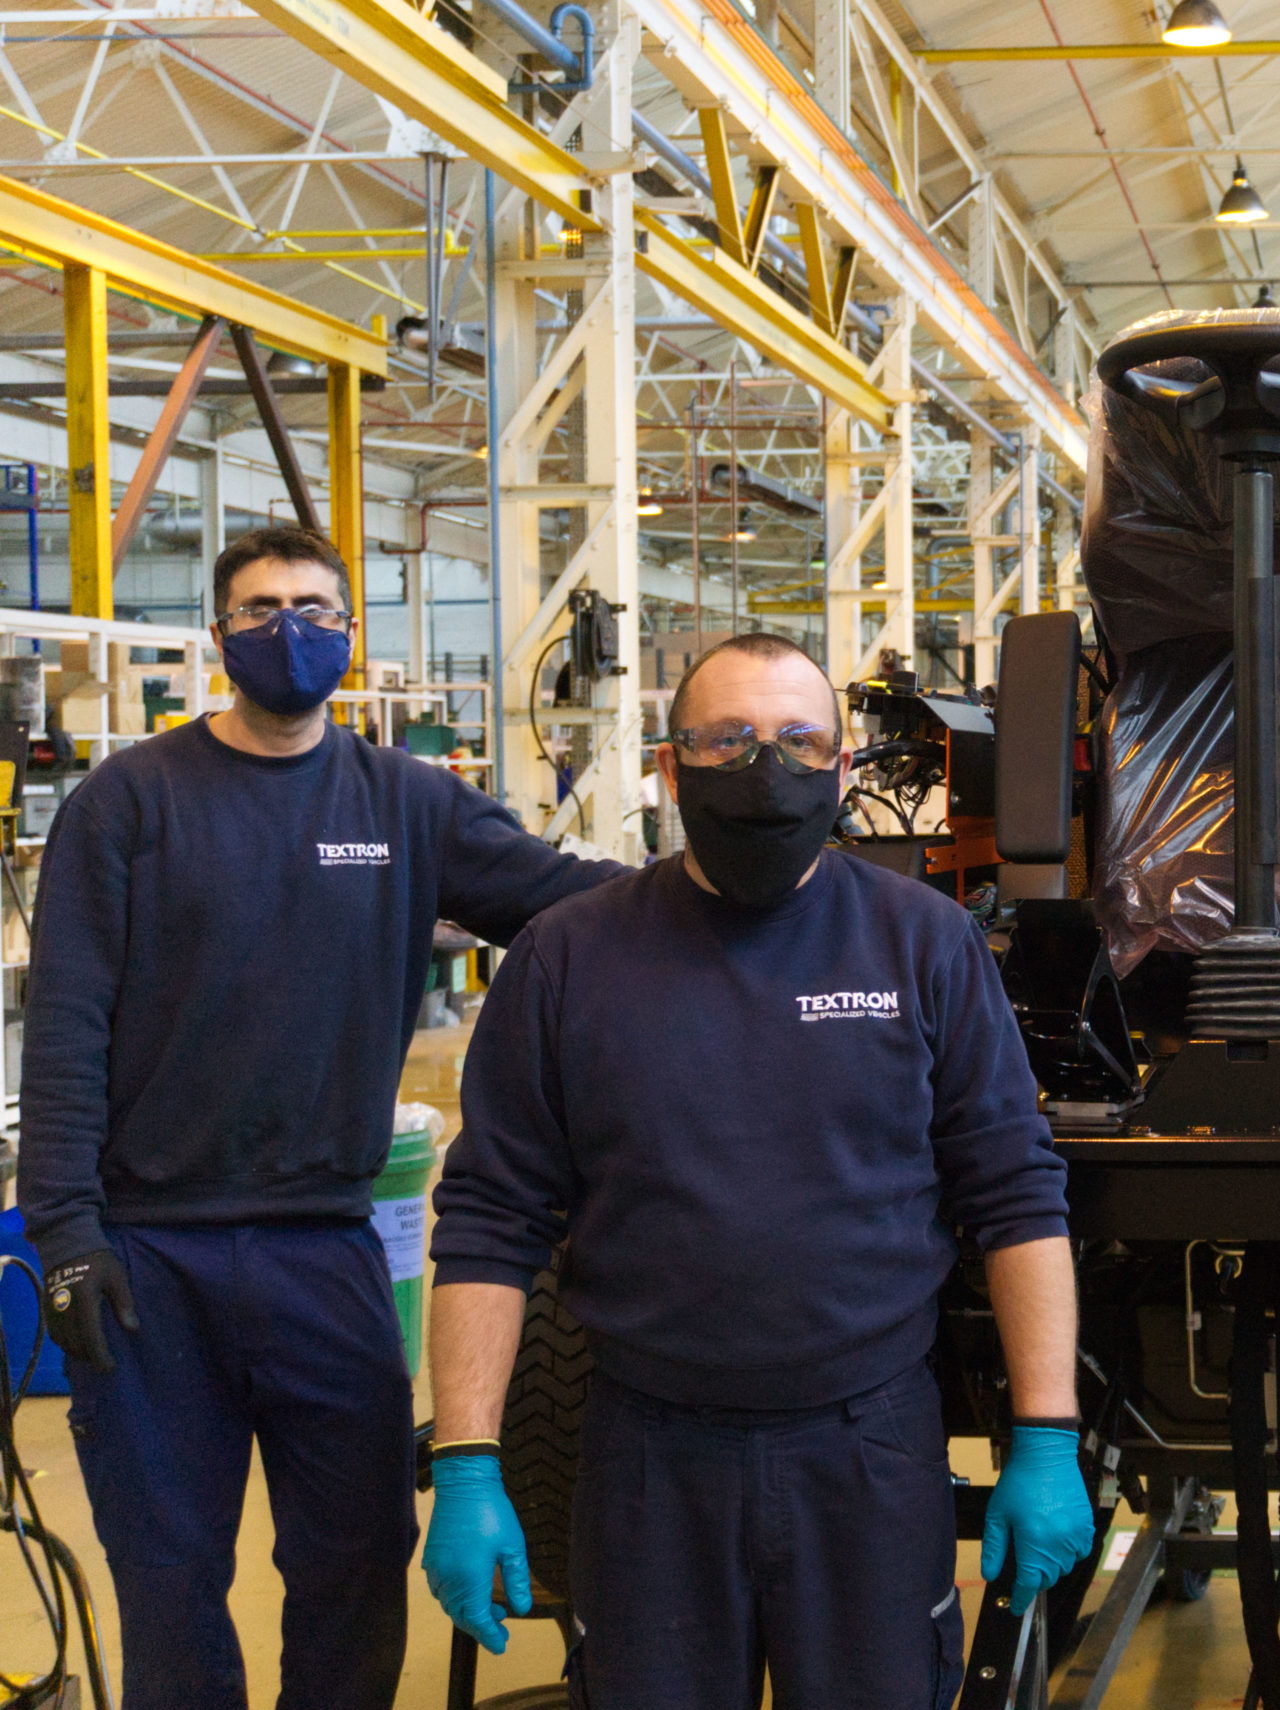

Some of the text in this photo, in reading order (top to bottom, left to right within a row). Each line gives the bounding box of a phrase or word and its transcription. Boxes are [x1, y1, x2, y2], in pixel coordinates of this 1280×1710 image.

[316, 843, 389, 857] TEXTRON
[796, 991, 898, 1012] TEXTRON
[820, 1010, 900, 1019] SPECIALIZED VEHICLES
